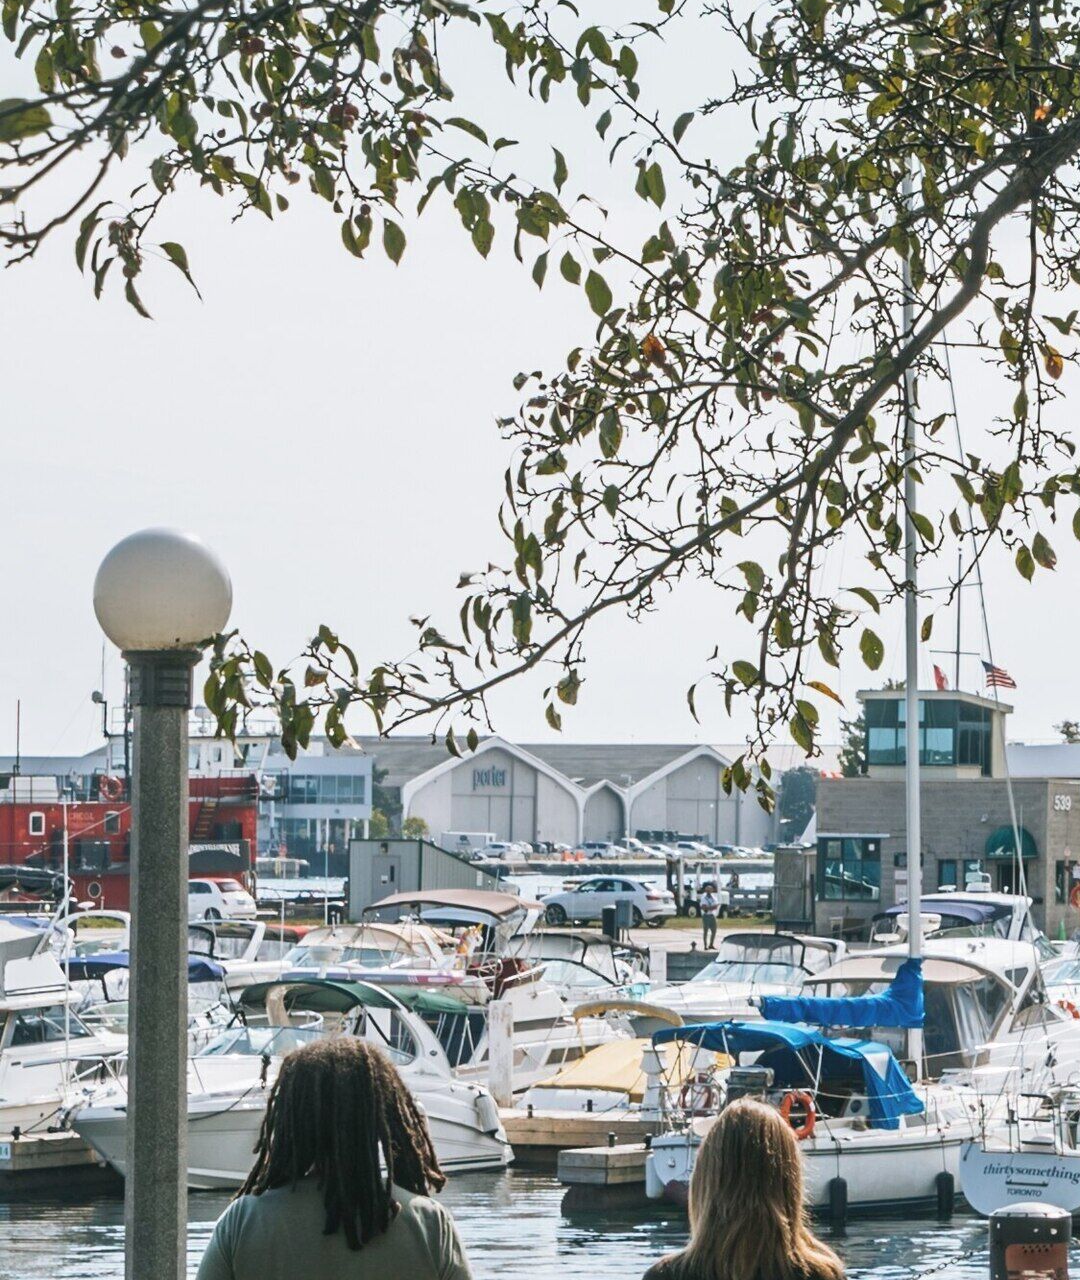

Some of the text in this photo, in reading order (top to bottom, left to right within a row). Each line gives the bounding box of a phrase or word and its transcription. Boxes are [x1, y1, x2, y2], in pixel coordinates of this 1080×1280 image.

[472, 765, 506, 791] porter
[1054, 795, 1072, 811] 539
[1007, 1188, 1042, 1198] TORONTO
